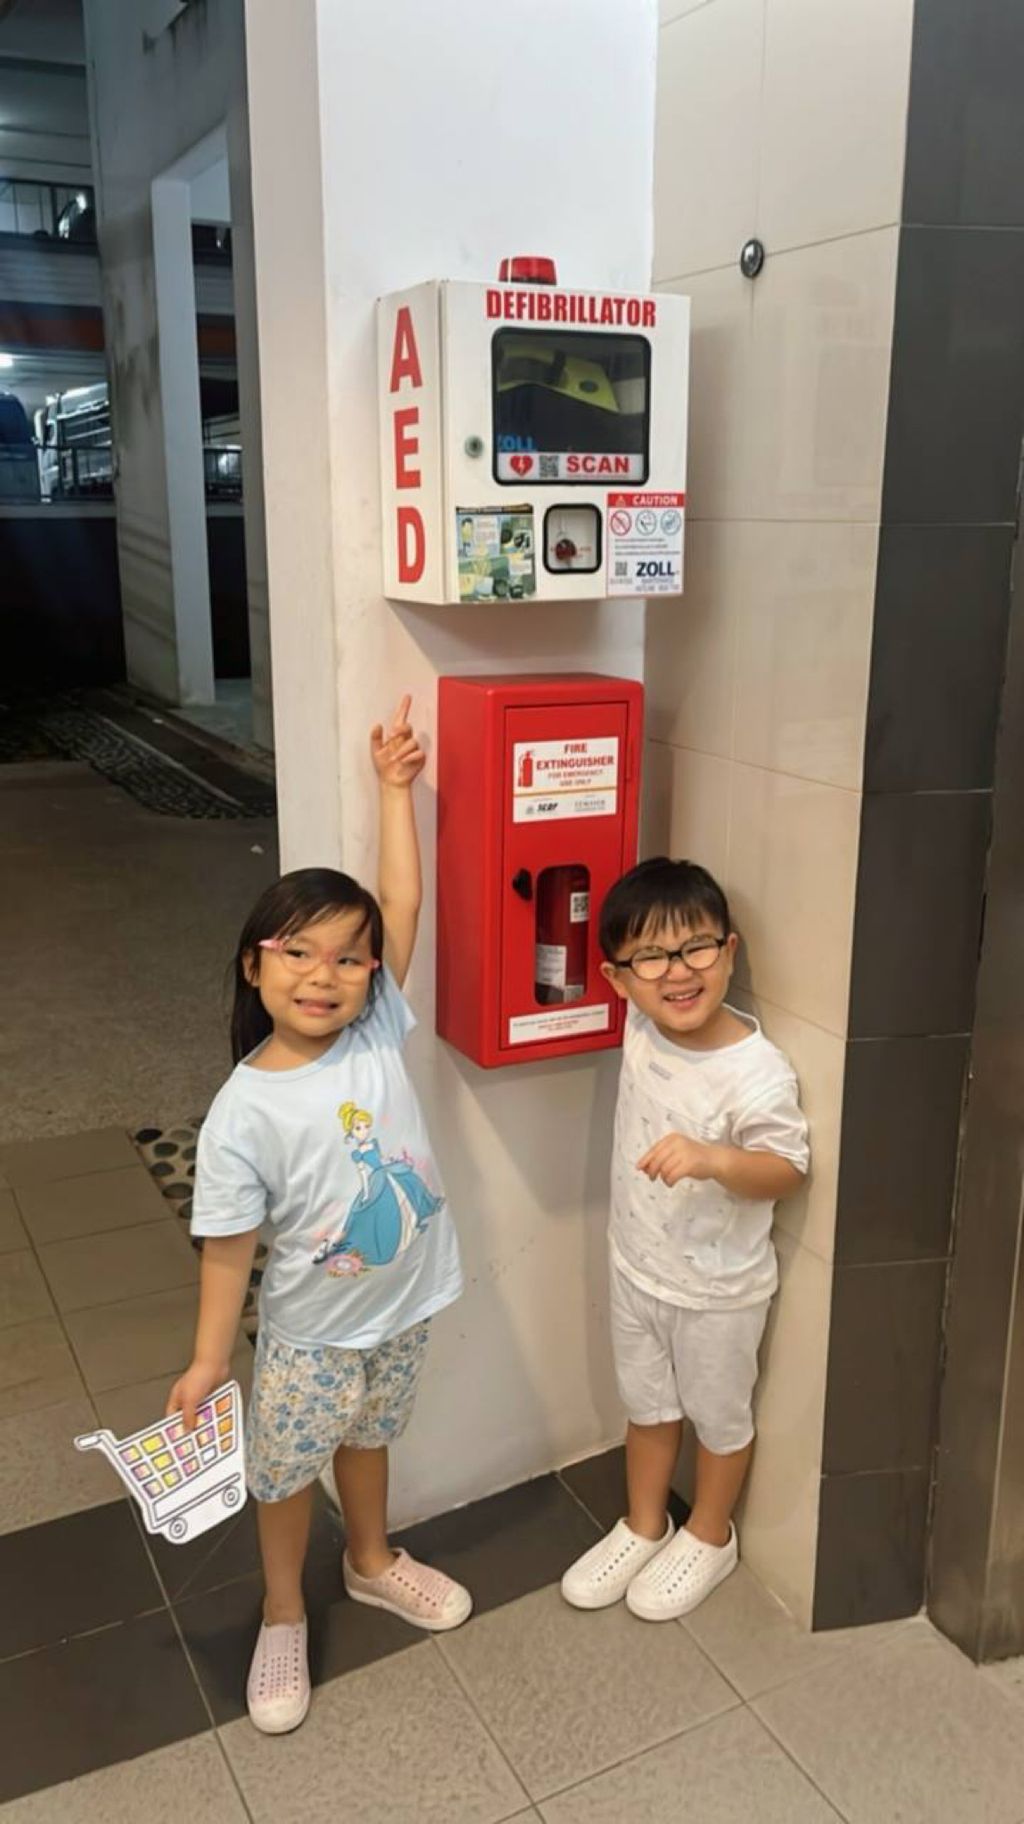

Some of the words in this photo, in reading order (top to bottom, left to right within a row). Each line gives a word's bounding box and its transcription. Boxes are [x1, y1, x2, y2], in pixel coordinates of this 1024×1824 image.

[486, 290, 656, 328] DEFIBRILLATOR
[566, 455, 630, 473] SCAN
[632, 495, 678, 505] CAUTION
[636, 561, 675, 577] ZOLL
[564, 743, 588, 754] FIRE
[536, 755, 615, 771] EXTINGUISHER
[563, 769, 604, 778] EMERGENCY
